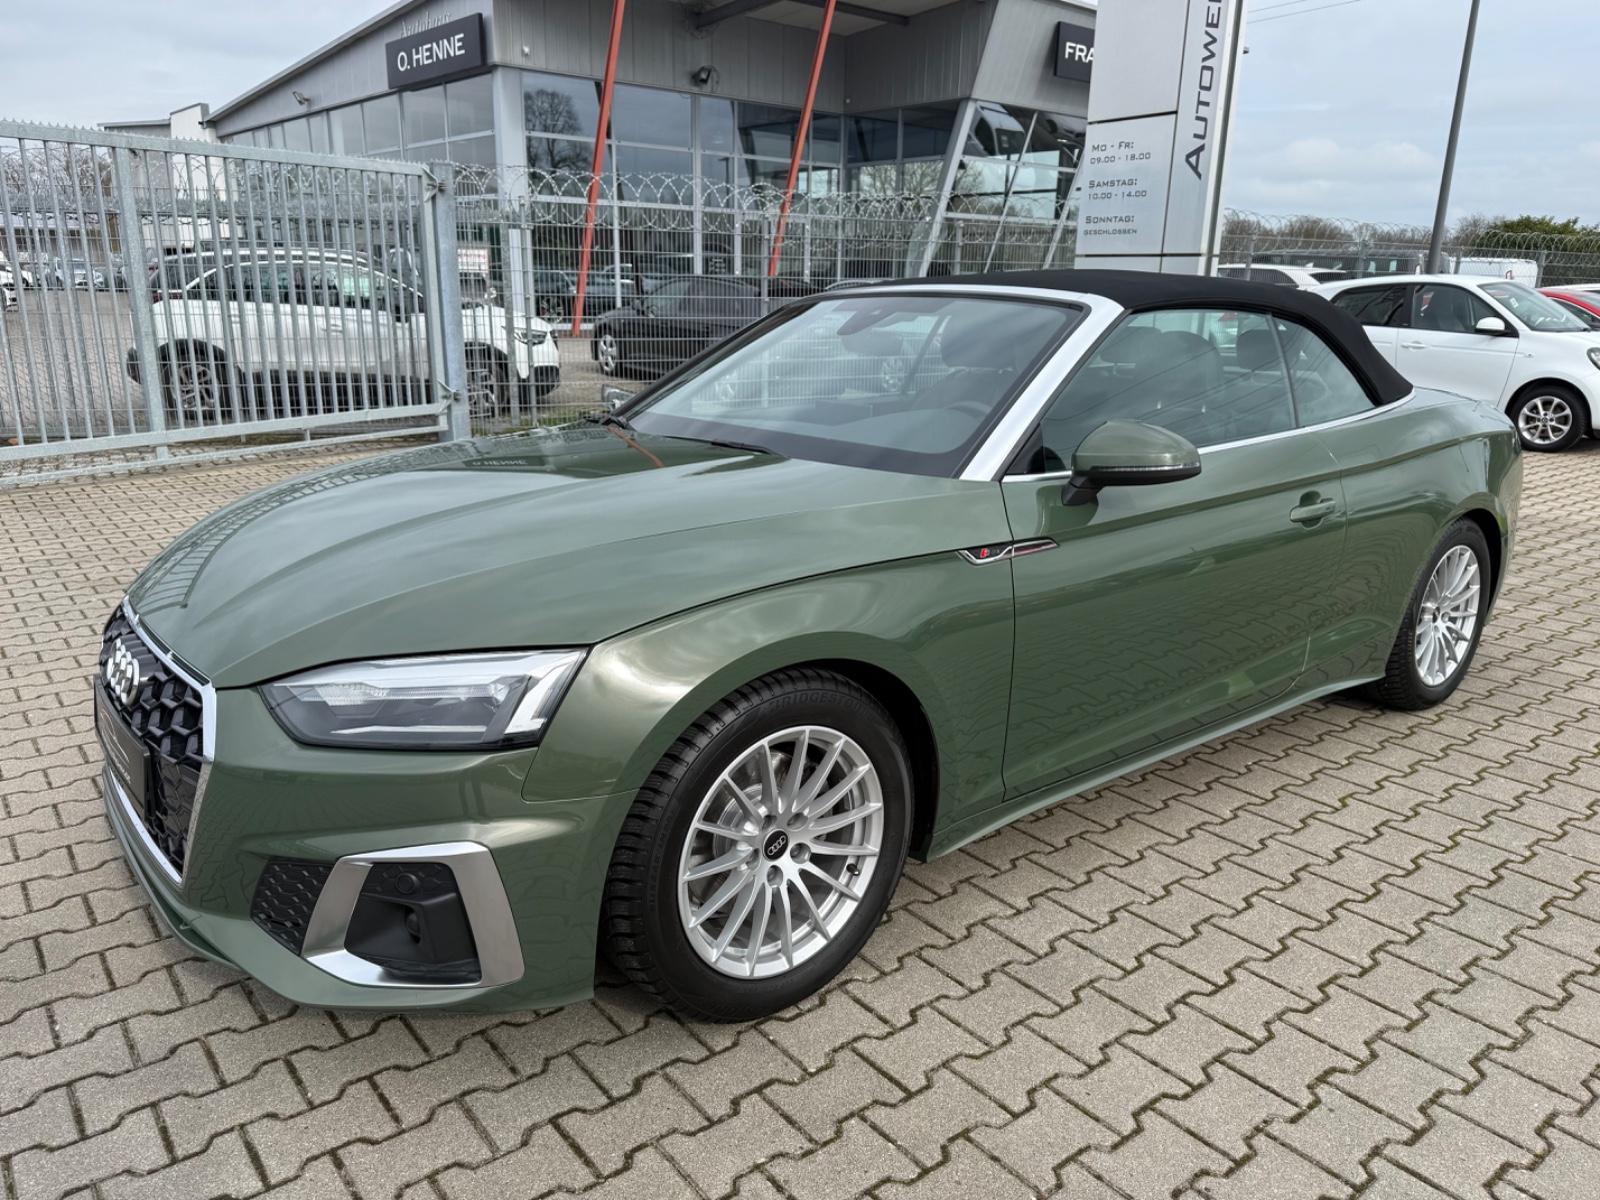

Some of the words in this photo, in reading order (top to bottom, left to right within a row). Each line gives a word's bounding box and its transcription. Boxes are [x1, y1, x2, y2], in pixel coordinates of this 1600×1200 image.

[397, 51, 410, 72] O.
[412, 33, 466, 67] HENNE
[1185, 0, 1222, 180] AUTOWE
[1090, 155, 1116, 164] 09.00
[1125, 152, 1151, 161] 18.00
[1088, 192, 1112, 200] 10.00
[1122, 190, 1147, 199] 14.00
